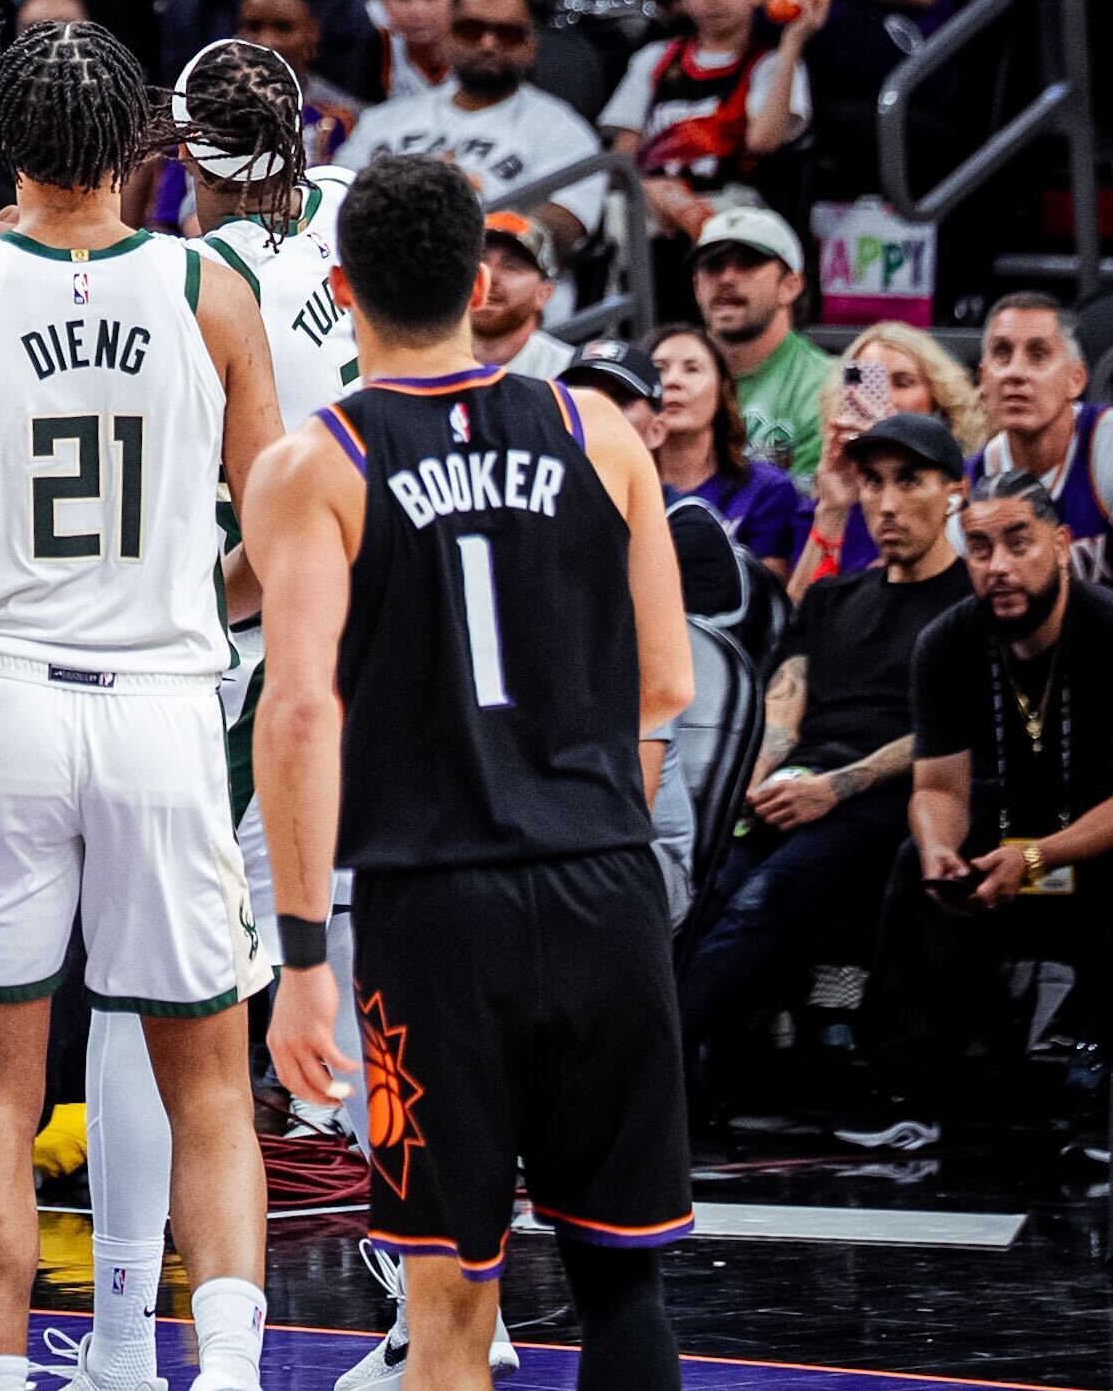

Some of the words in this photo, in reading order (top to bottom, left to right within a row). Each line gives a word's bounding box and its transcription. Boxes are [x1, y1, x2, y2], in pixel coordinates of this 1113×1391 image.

[20, 319, 151, 381] DIENG
[30, 414, 144, 560] 21
[387, 449, 565, 529] BOOKER
[456, 533, 515, 708] 1
